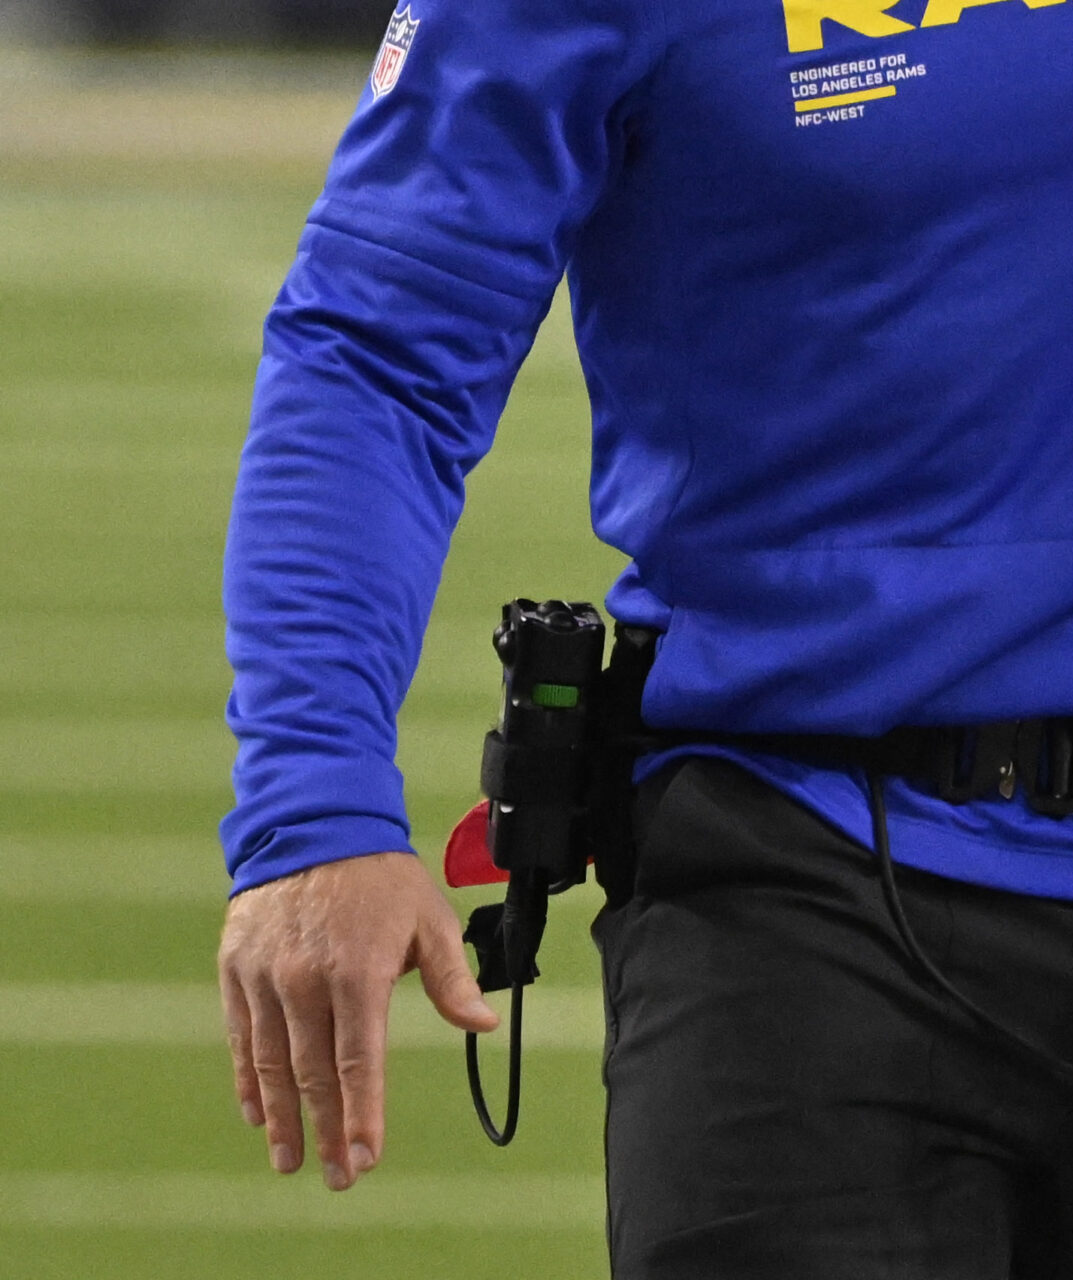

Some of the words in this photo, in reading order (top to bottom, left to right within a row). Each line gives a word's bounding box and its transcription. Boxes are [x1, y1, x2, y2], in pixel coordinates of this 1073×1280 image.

[790, 59, 877, 84] ENGINEERED
[879, 53, 907, 69] FOR
[792, 82, 818, 98] LOS
[821, 72, 884, 94] ANGELES
[886, 64, 927, 82] RAMS
[795, 105, 865, 127] NFC-WEST
